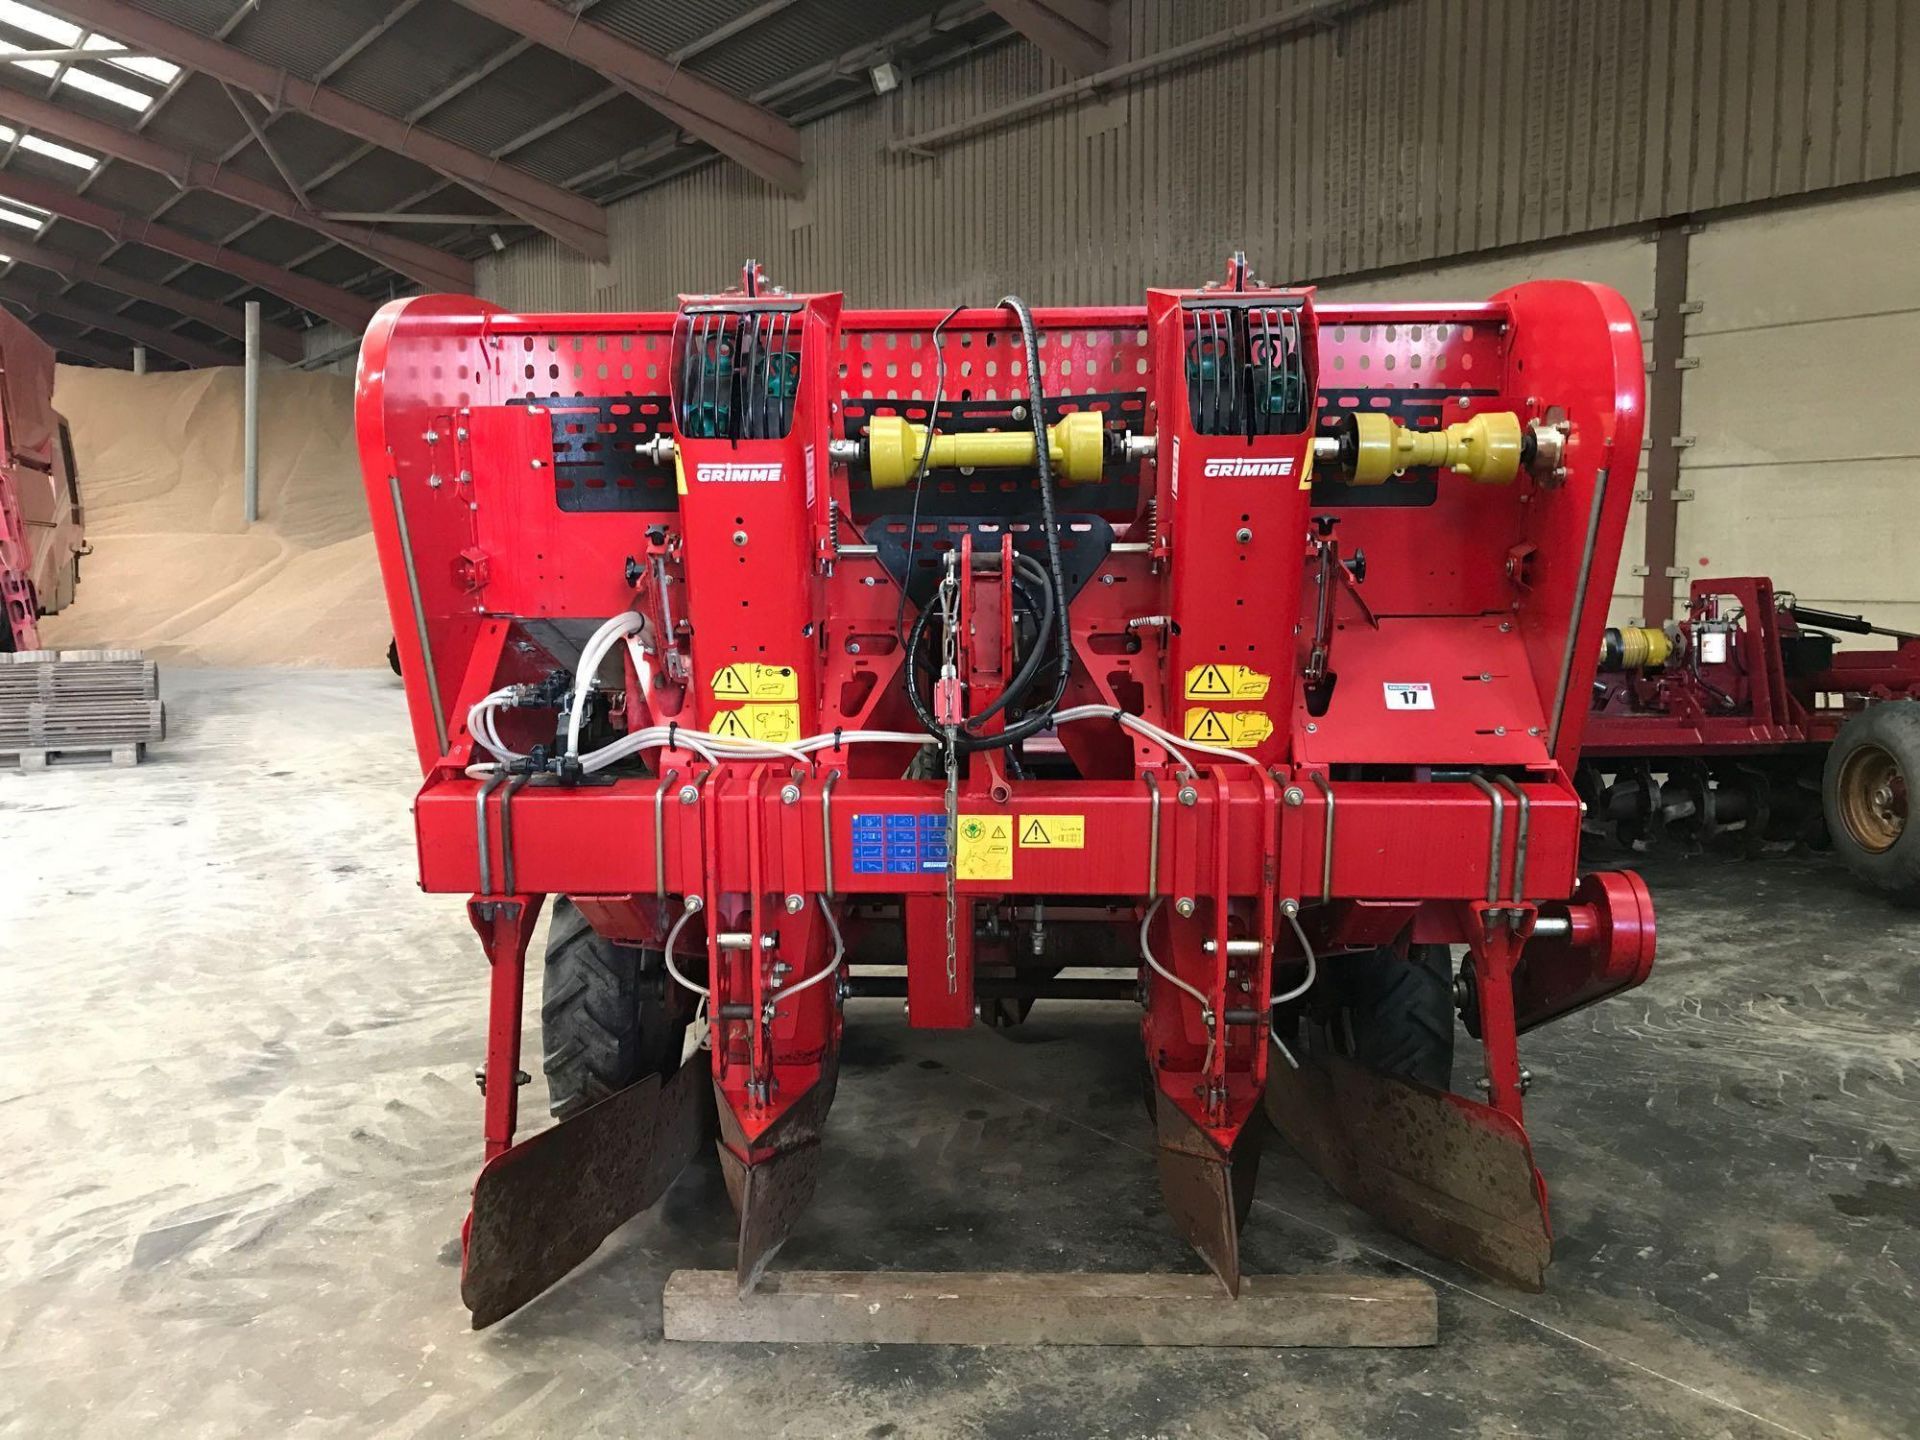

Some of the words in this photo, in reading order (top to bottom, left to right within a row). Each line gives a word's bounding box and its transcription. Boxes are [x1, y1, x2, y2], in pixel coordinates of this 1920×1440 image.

[696, 463, 782, 482] GRIMME
[1204, 457, 1294, 477] GRIMME
[1400, 690, 1418, 704] 17
